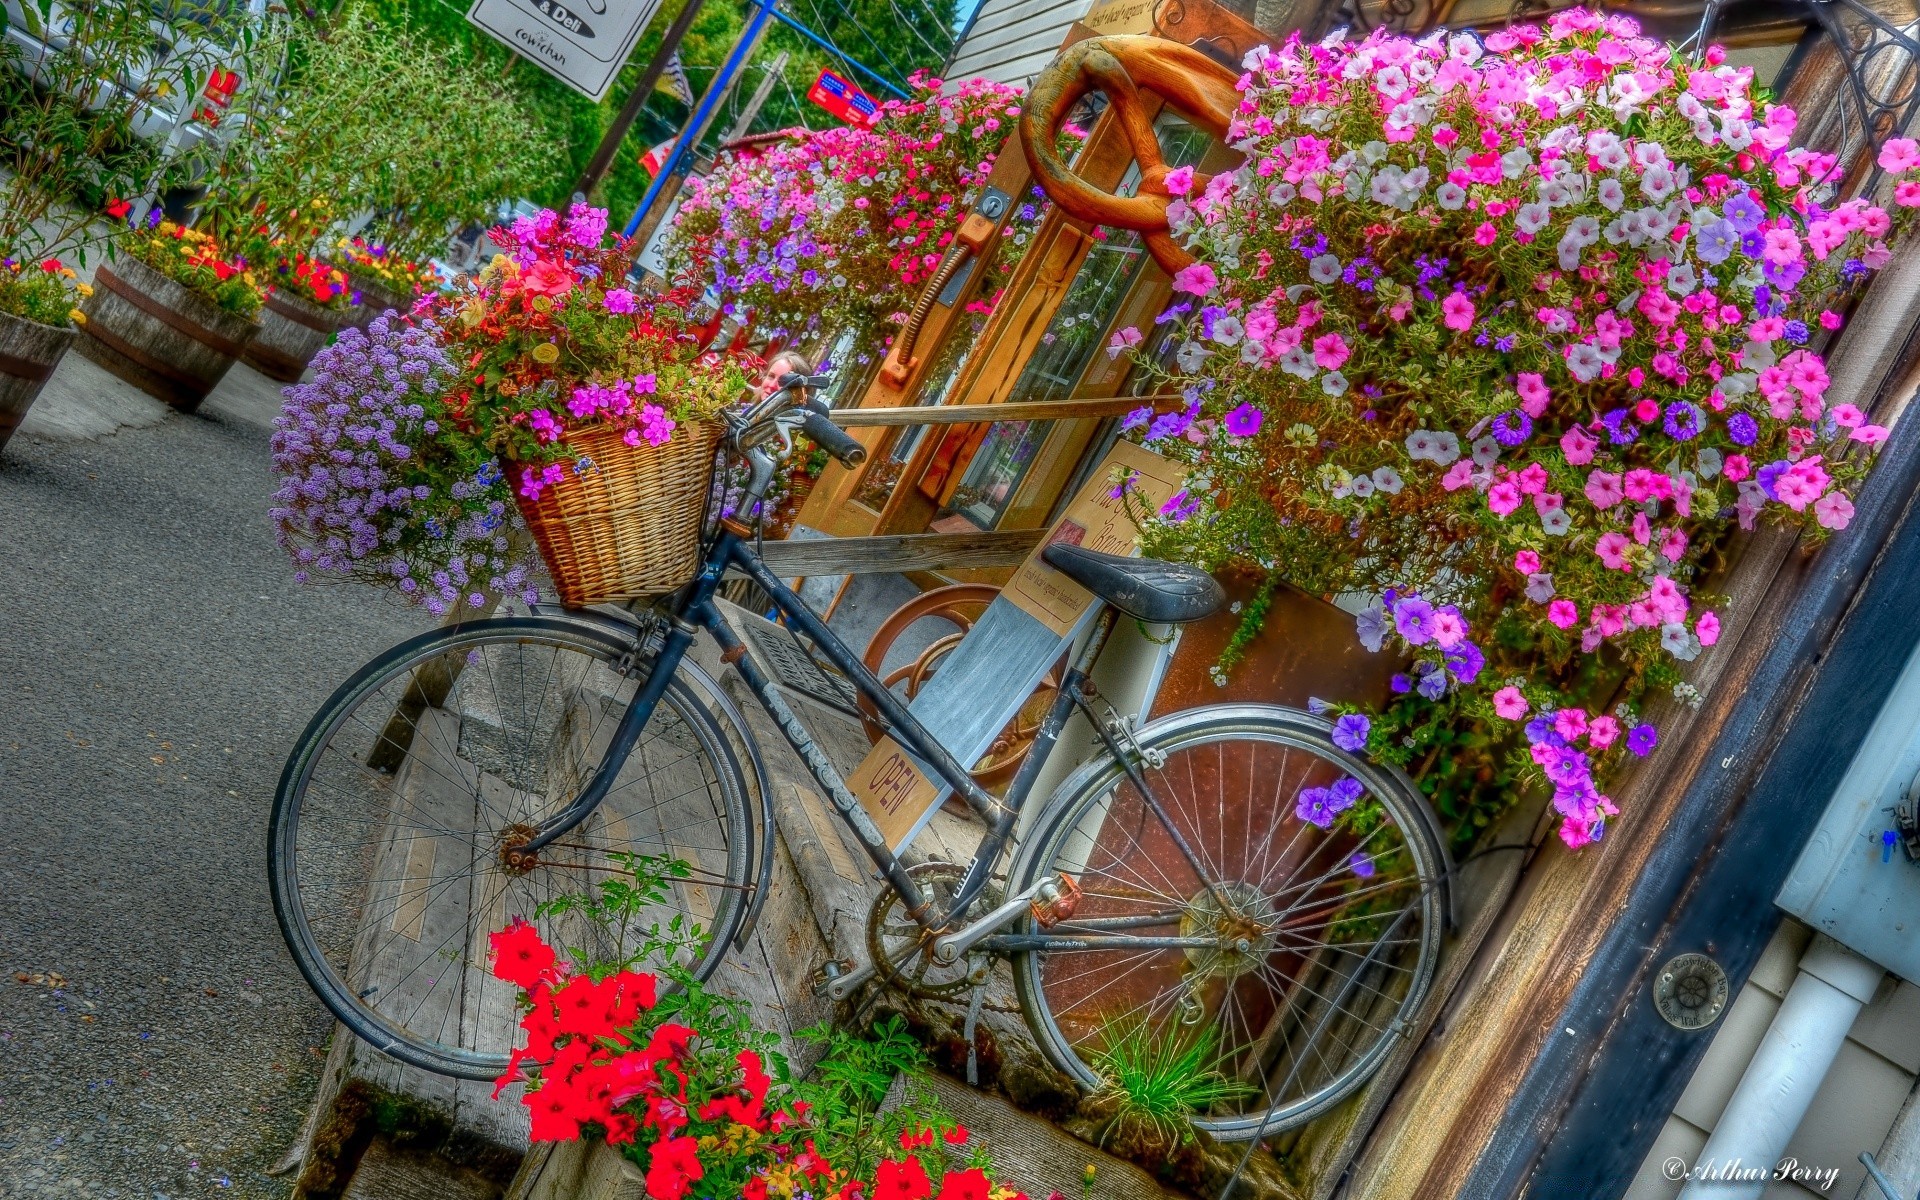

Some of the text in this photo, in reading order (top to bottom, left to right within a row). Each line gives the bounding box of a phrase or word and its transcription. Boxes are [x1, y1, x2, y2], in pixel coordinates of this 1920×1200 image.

[539, 1, 582, 33] & Deli
[869, 752, 920, 817] OPEN
[1673, 956, 1728, 997] Cowichan Bay
[1658, 996, 1702, 1027] Village Walk
